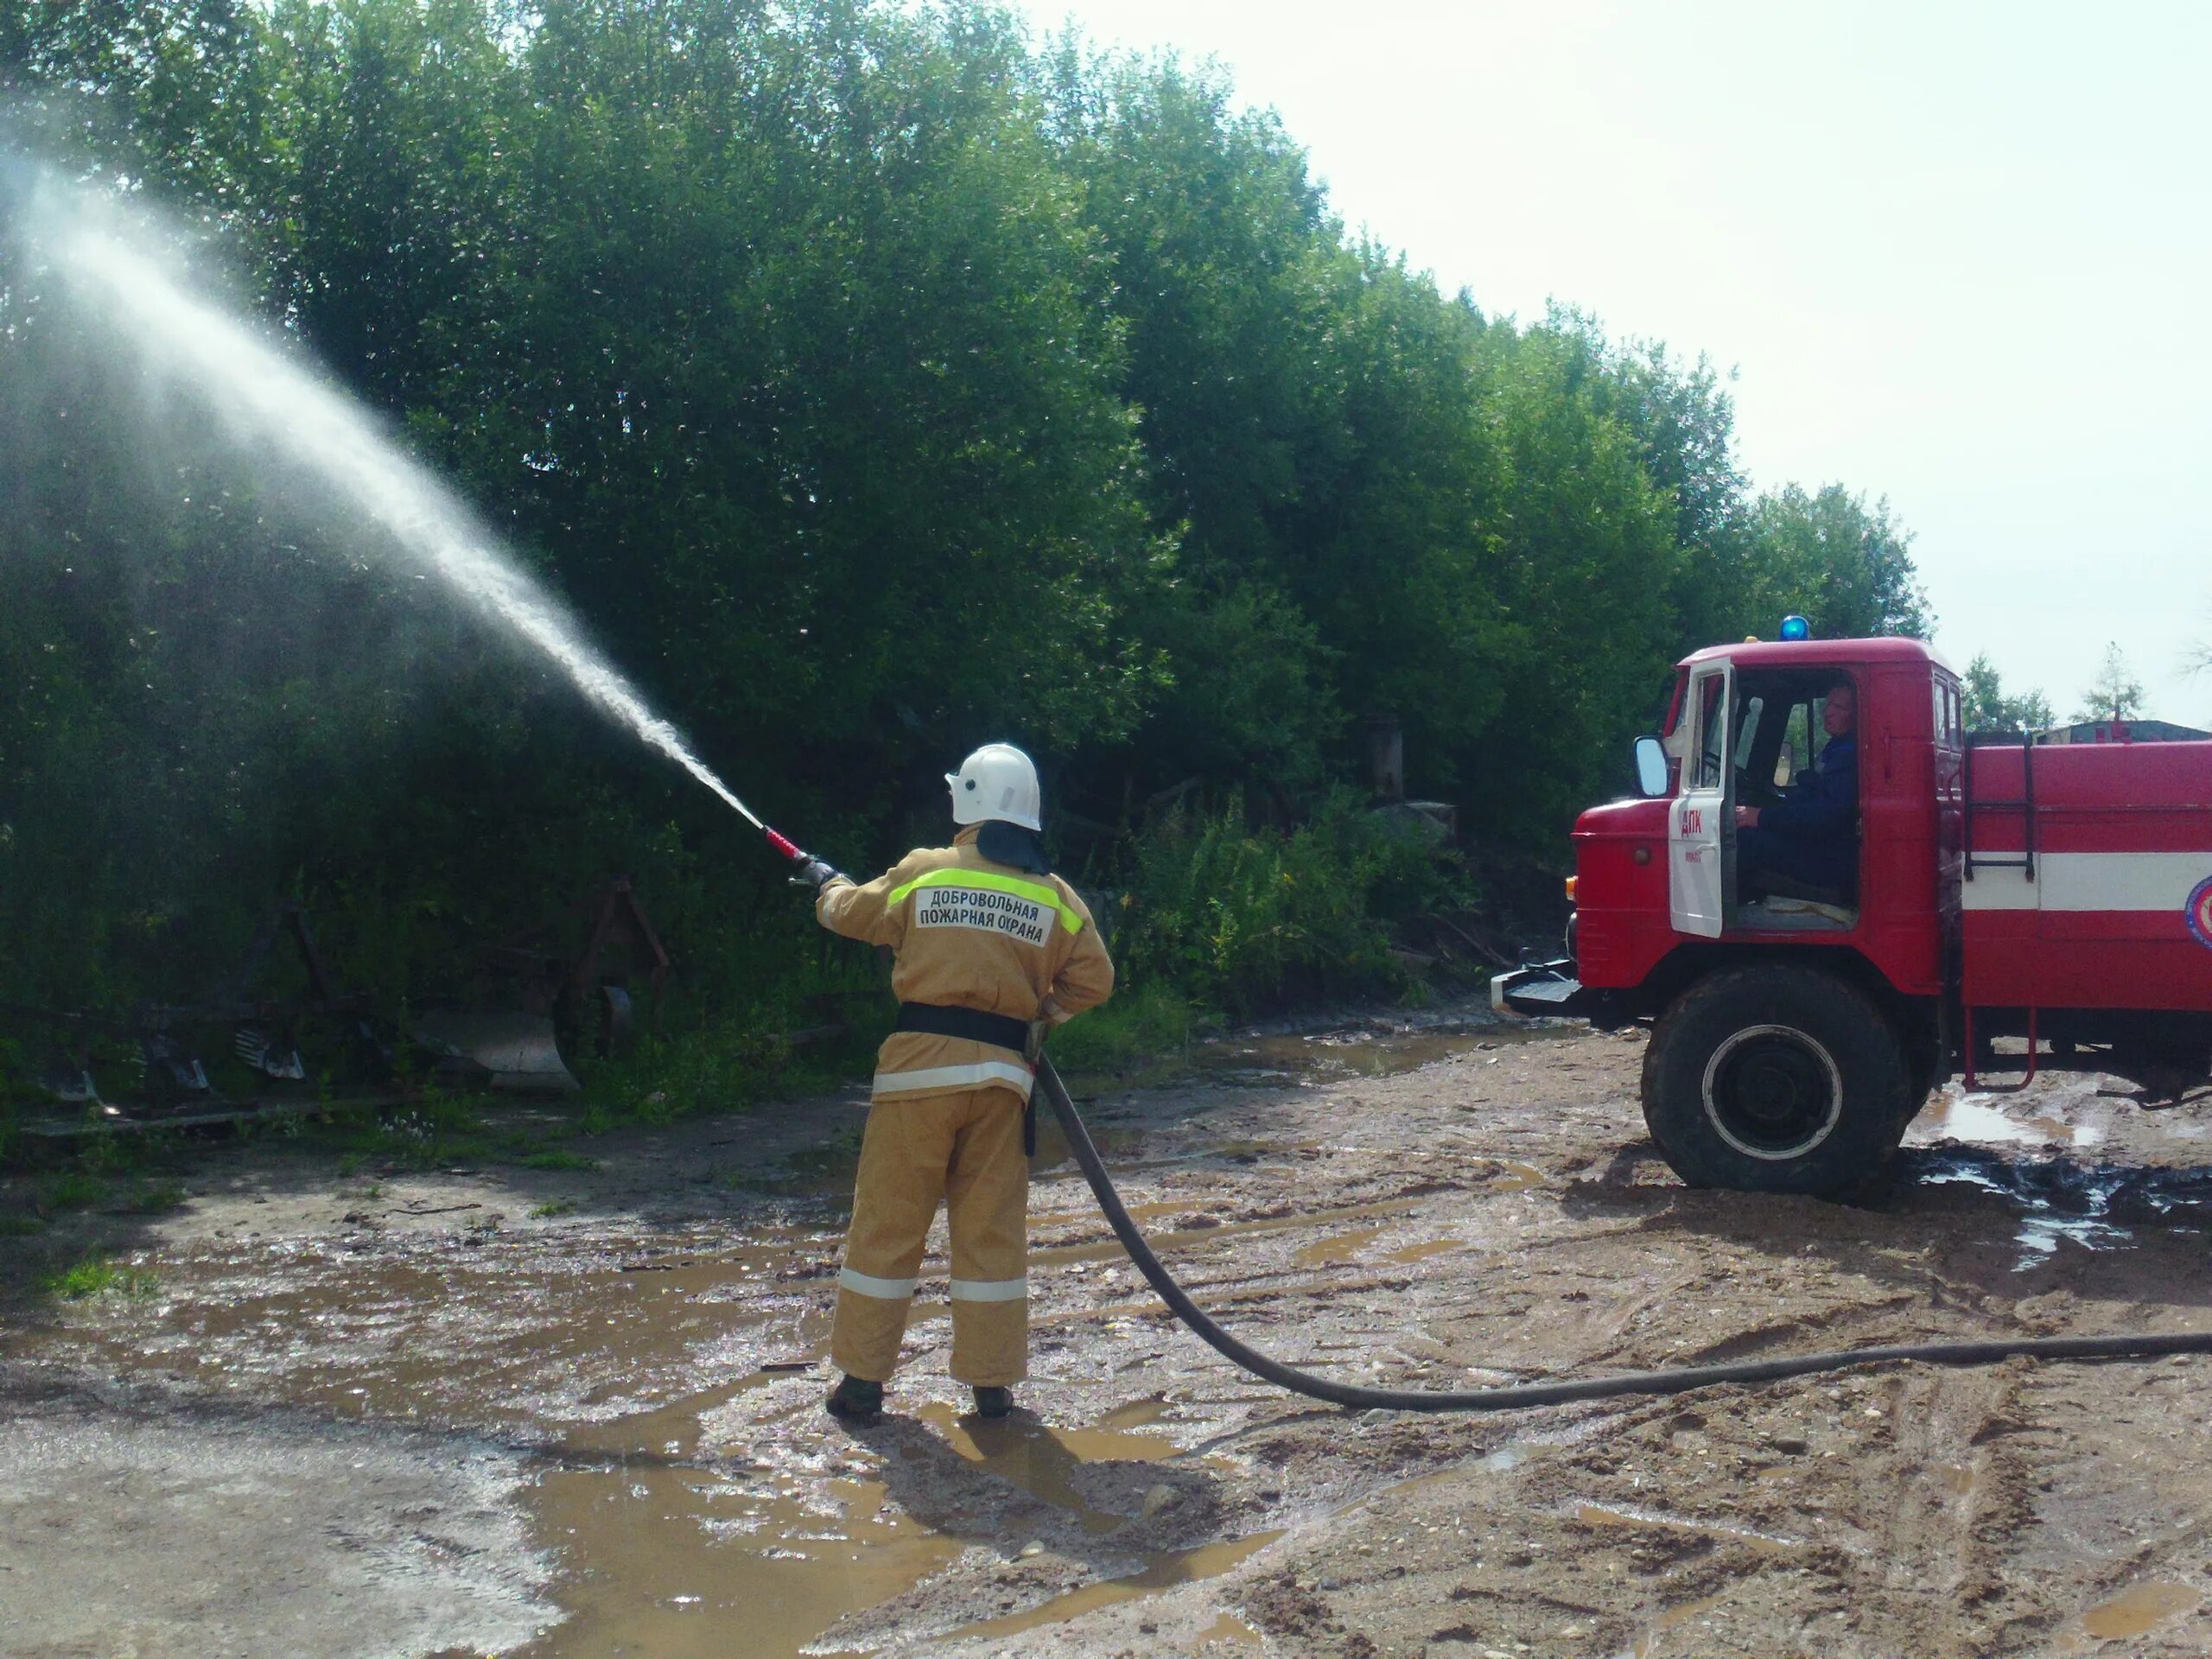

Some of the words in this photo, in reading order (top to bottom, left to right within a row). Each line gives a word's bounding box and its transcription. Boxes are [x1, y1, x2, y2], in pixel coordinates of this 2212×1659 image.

[1681, 809, 1701, 839] ДПК
[931, 891, 1039, 921] ДОБРОВОЛЬНАЯ
[920, 909, 995, 927] ПОЖАРНАЯ
[997, 914, 1043, 942] ОХРАНА
